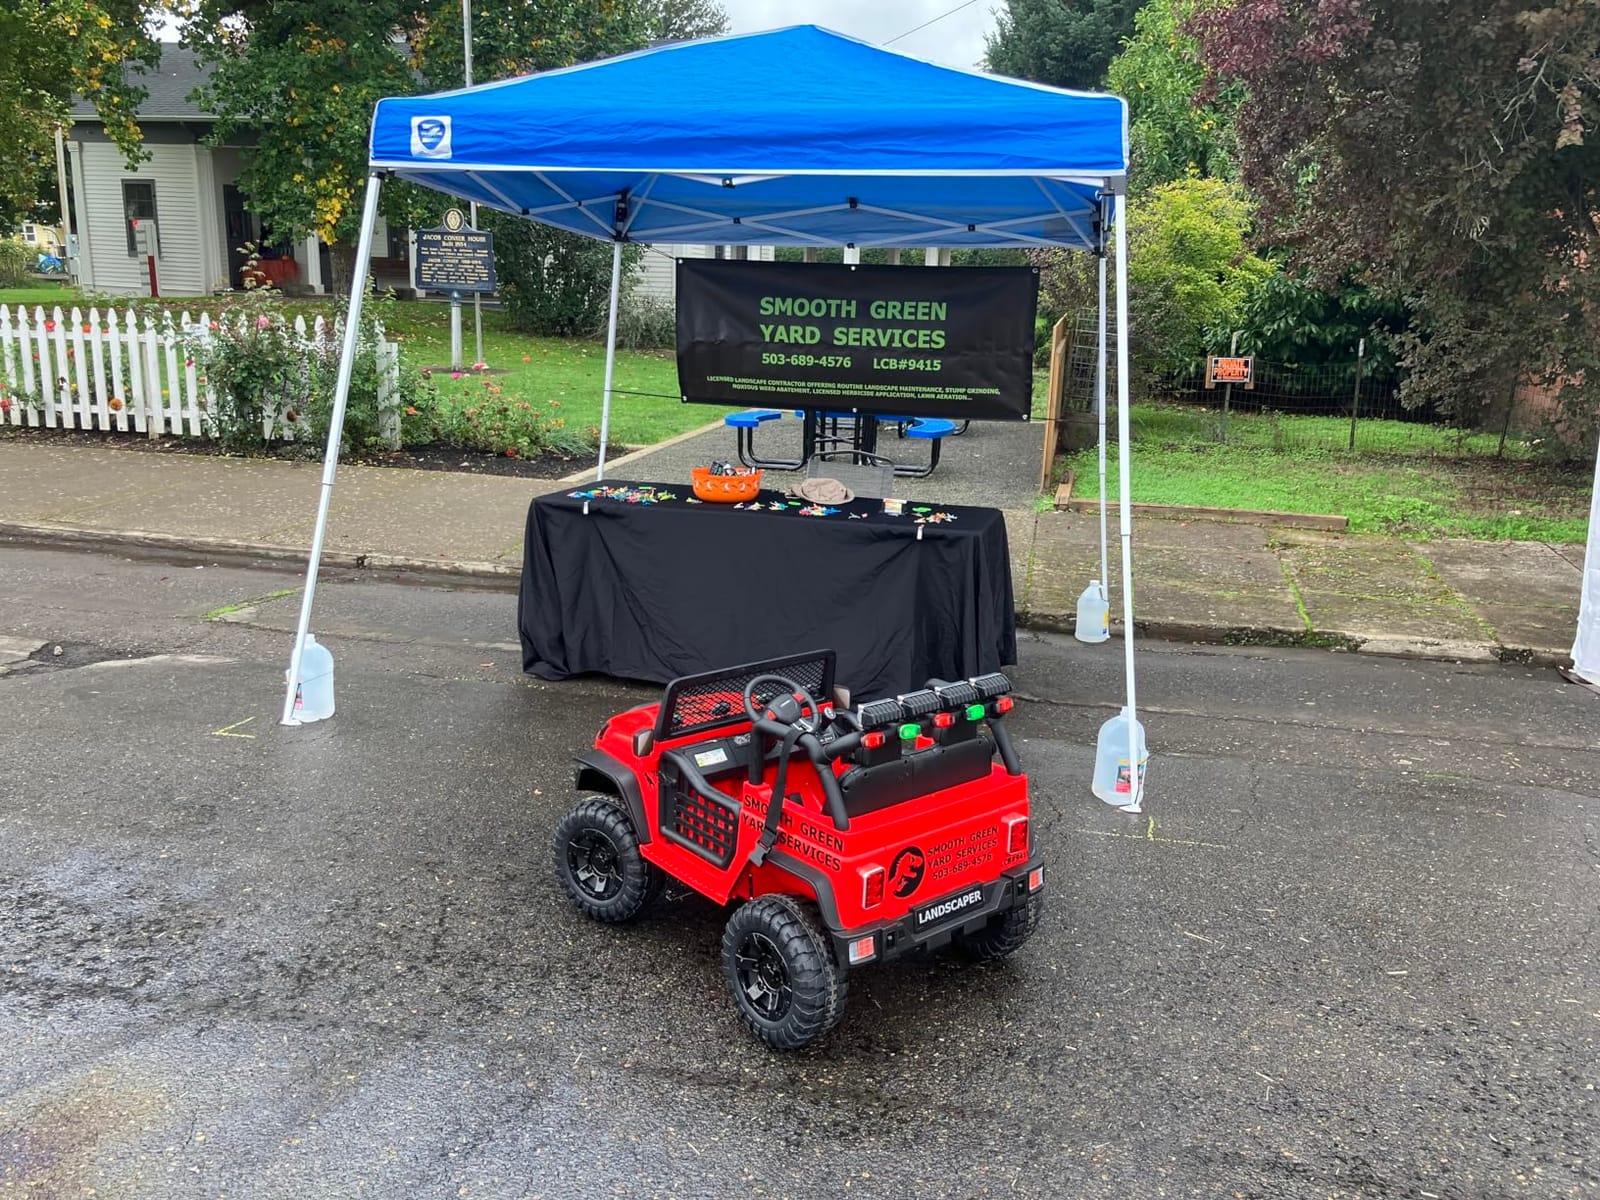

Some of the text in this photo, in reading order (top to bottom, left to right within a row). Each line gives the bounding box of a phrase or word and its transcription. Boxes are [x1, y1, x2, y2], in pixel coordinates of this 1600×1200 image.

[759, 296, 947, 321] SMOOTH GREEN
[759, 323, 946, 349] YARD SERVICES
[762, 352, 942, 371] 503-689-4576 LCB#9415
[706, 375, 734, 383] LICENSED
[734, 377, 767, 385] LANDSCAPE
[767, 379, 806, 388] CONTRACTOR
[807, 381, 836, 389] OFFERING
[837, 382, 863, 390] ROUTINE
[864, 384, 898, 392] LANDSCAPE
[900, 385, 944, 394] MAINTENANCE,
[967, 388, 1000, 396] GRINDING,
[732, 383, 758, 391] NOXIOUS
[776, 386, 812, 394] ABATEMENT,
[875, 391, 916, 399] APPLICATION,
[744, 794, 844, 852] SMOTH GREEN
[743, 813, 841, 871] YAR SERVICES
[928, 825, 998, 857] SMOOTH GREEN
[928, 839, 997, 869] YARD SERVICES
[933, 853, 992, 880] 503-689-4576
[918, 890, 982, 924] LANDSCAPER
